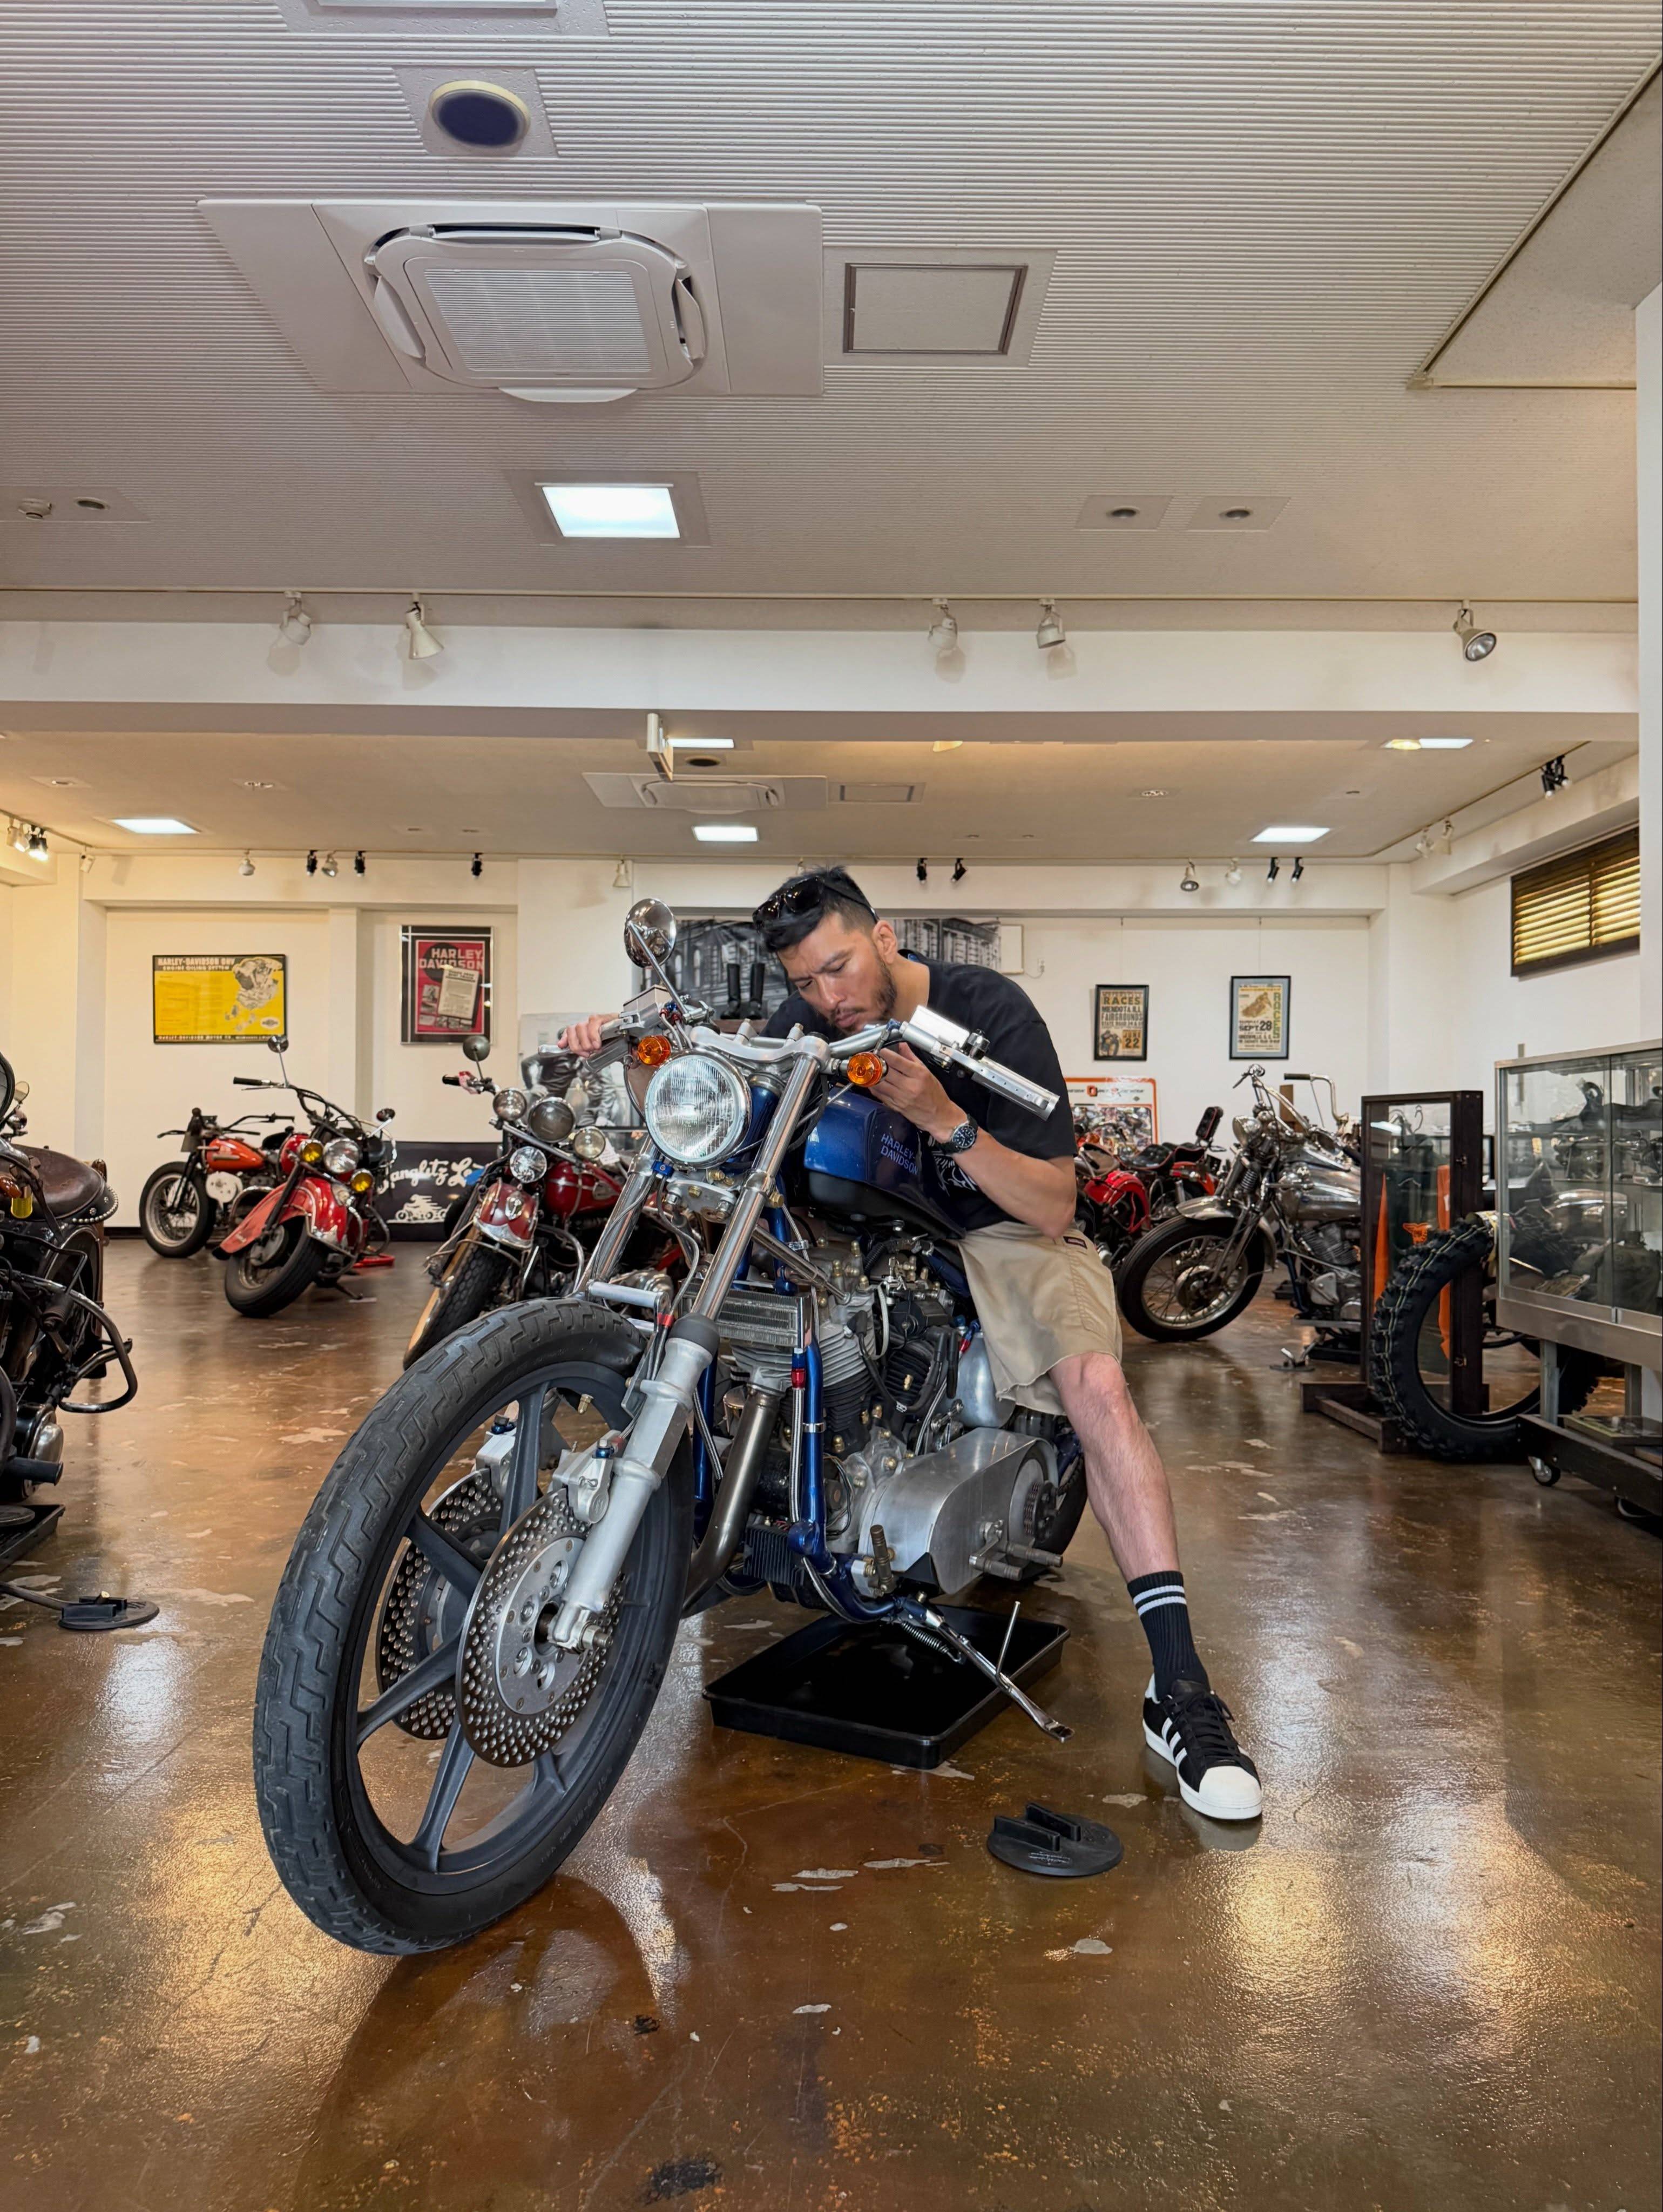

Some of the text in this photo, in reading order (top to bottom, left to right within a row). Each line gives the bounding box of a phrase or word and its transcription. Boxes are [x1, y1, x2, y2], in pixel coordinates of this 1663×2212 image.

[1104, 996, 1141, 1004] RACES
[1260, 1020, 1272, 1031] 28
[1125, 1037, 1139, 1048] 22
[881, 1145, 918, 1175] DAVIDSON
